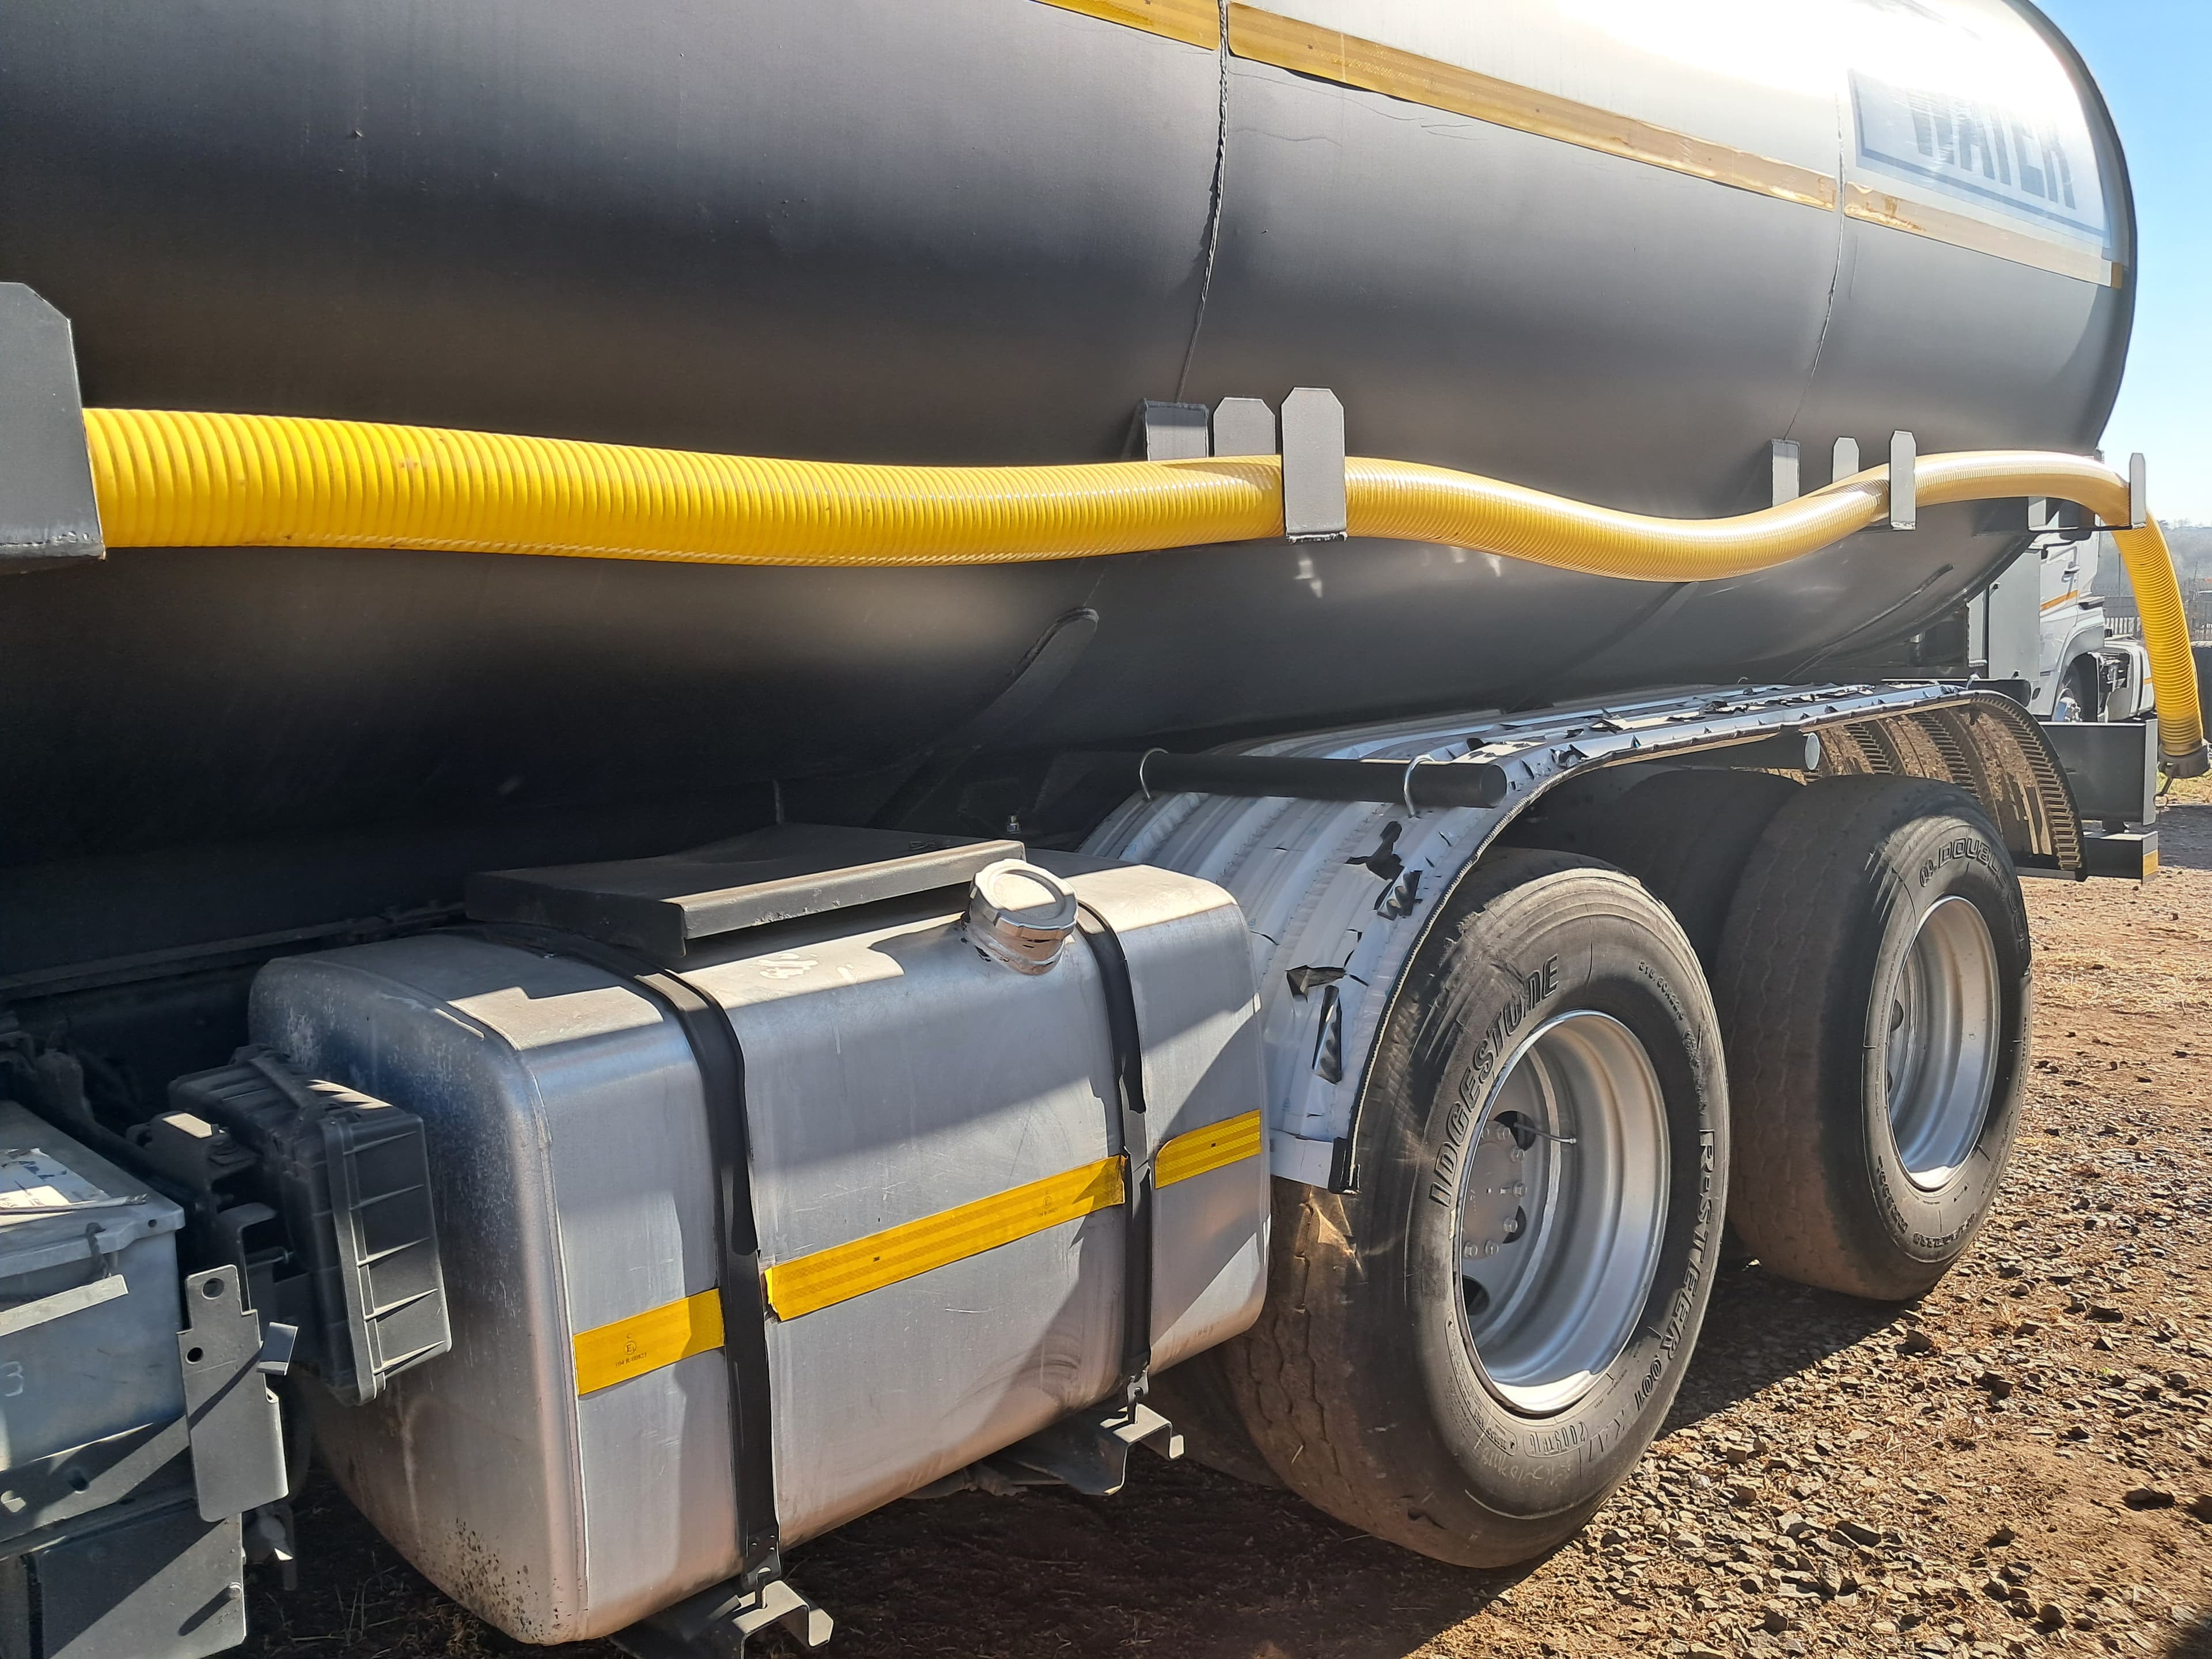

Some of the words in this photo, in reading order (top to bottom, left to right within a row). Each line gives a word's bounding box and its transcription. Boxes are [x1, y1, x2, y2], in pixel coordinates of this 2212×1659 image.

[1938, 837, 2007, 889] DOUBLE
[1429, 954, 1558, 1209] IDGESTONE
[1659, 1129, 1716, 1361] R-STEER
